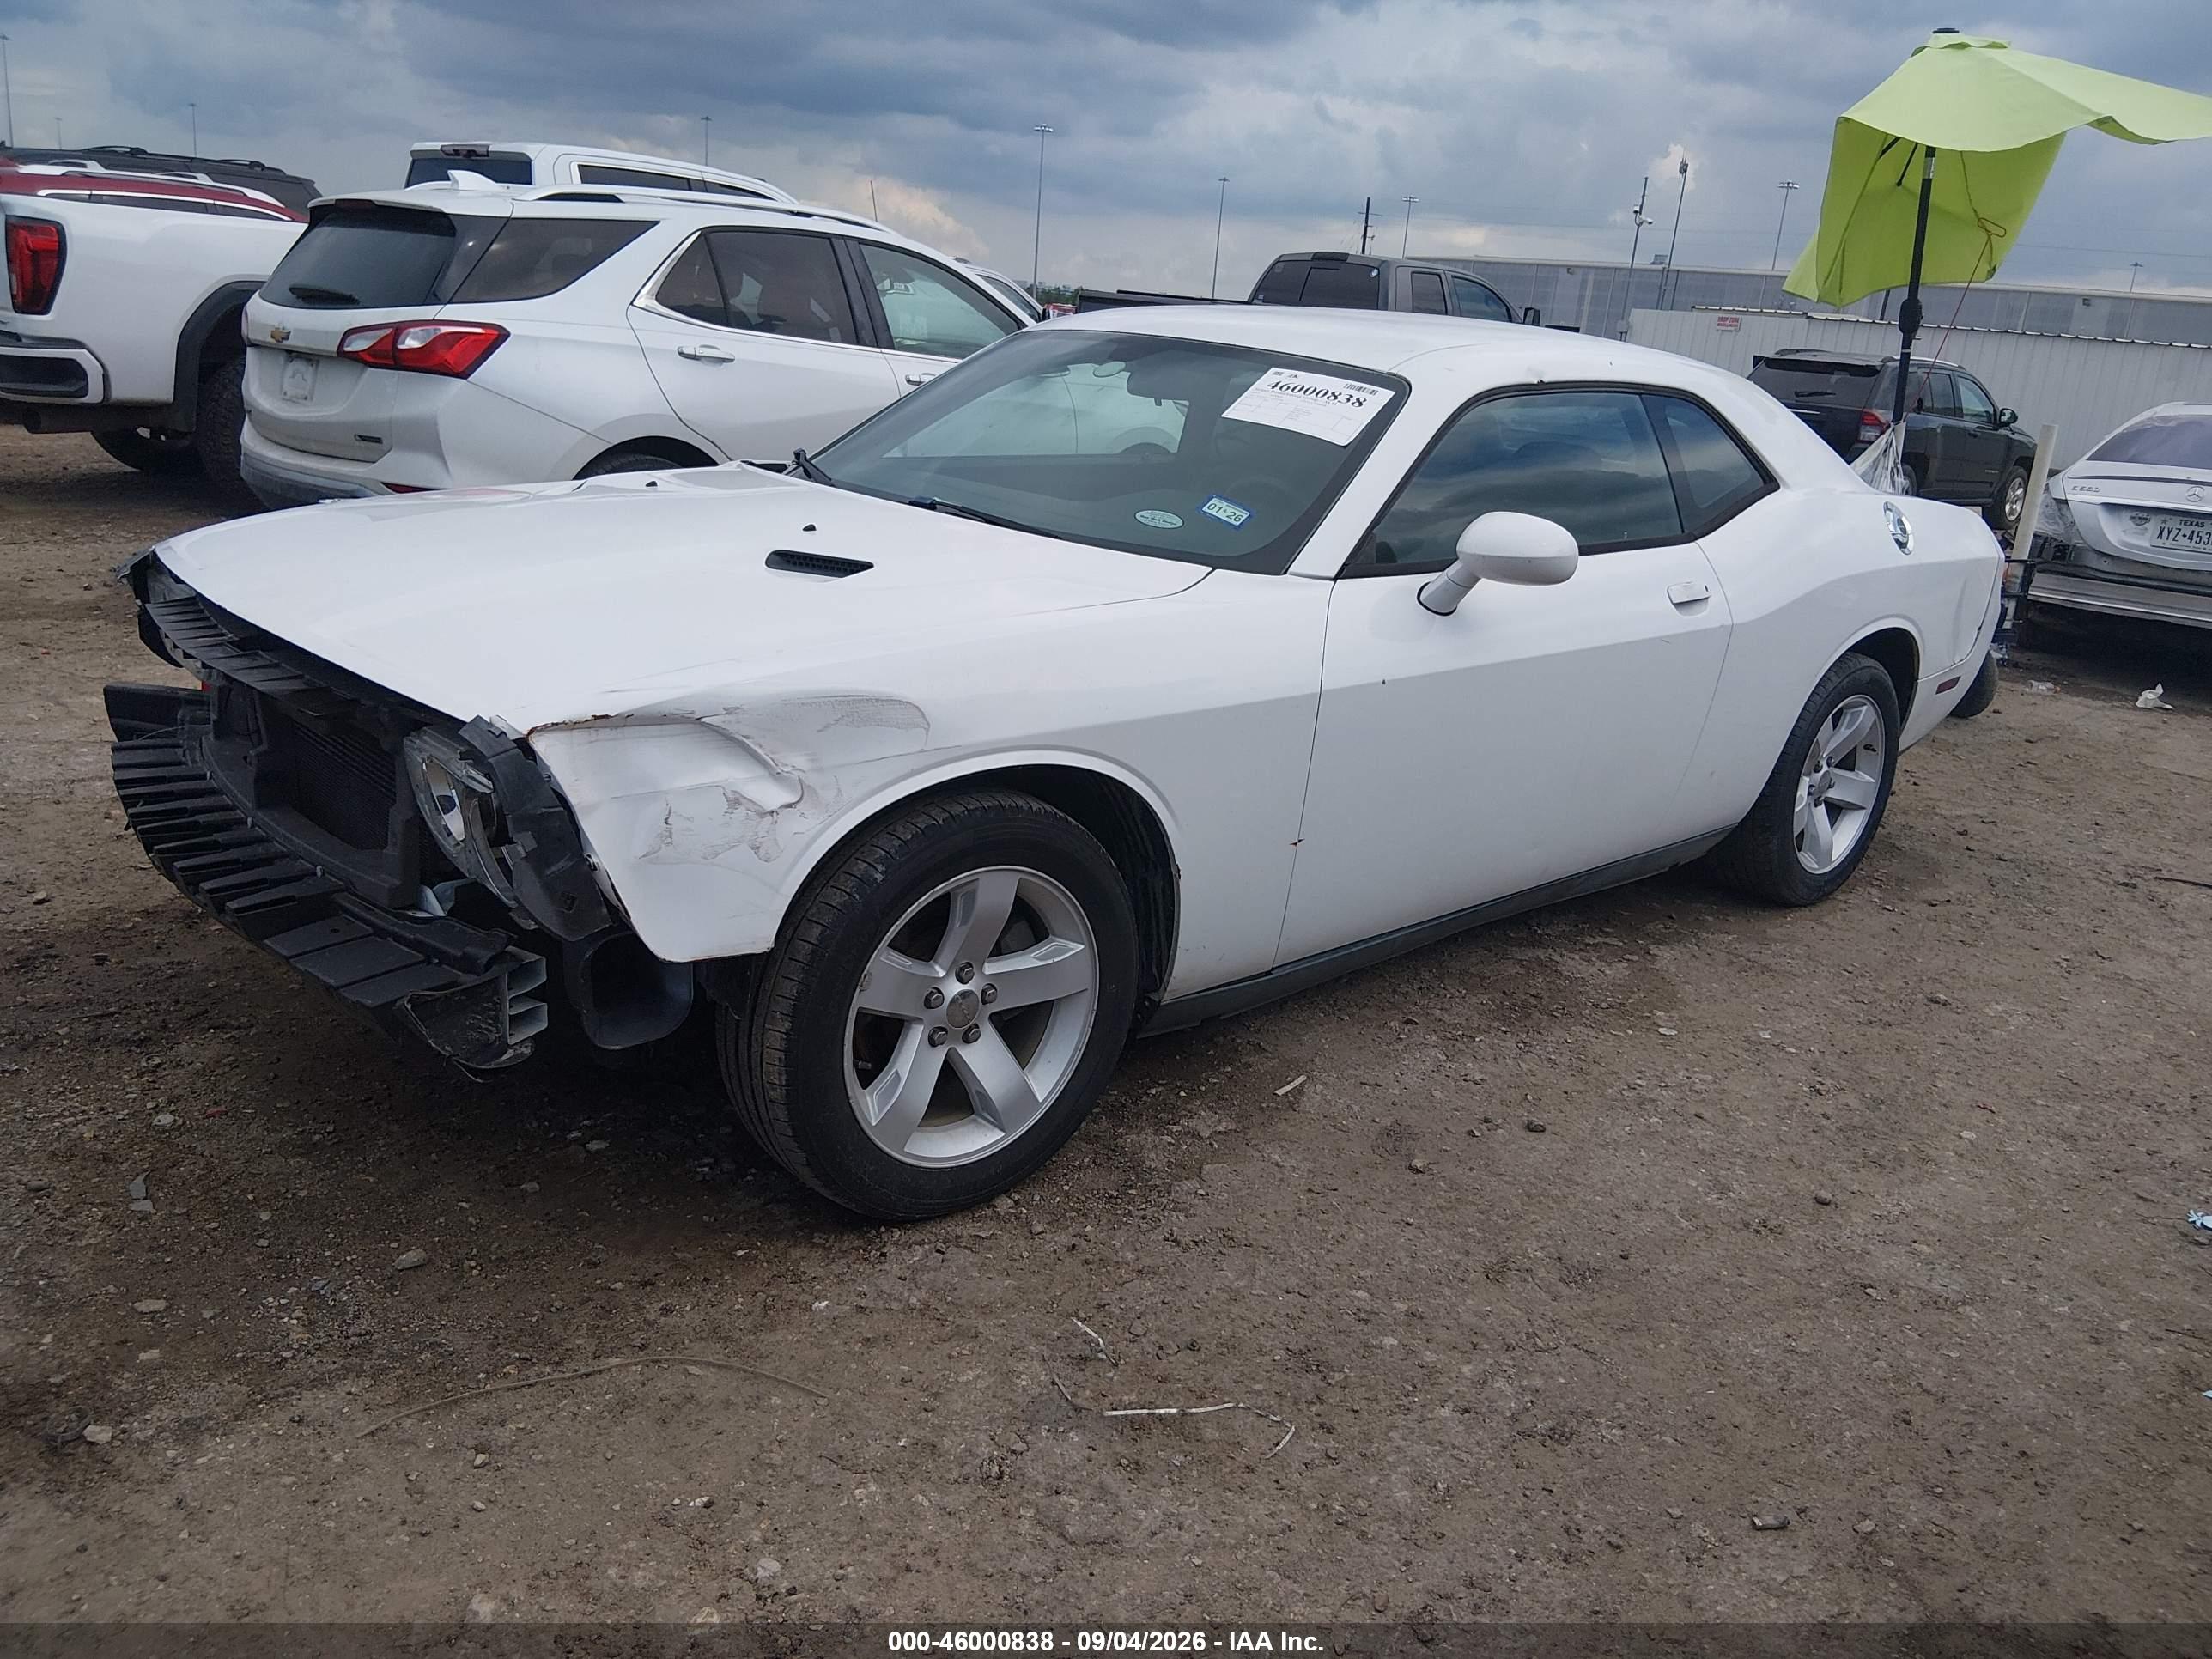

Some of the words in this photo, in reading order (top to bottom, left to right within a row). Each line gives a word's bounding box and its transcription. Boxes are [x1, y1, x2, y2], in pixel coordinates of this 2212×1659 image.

[1267, 380, 1367, 408] 46000838
[1207, 502, 1223, 514] 01
[1226, 511, 1244, 523] 26
[2179, 519, 2205, 528] TEXAS
